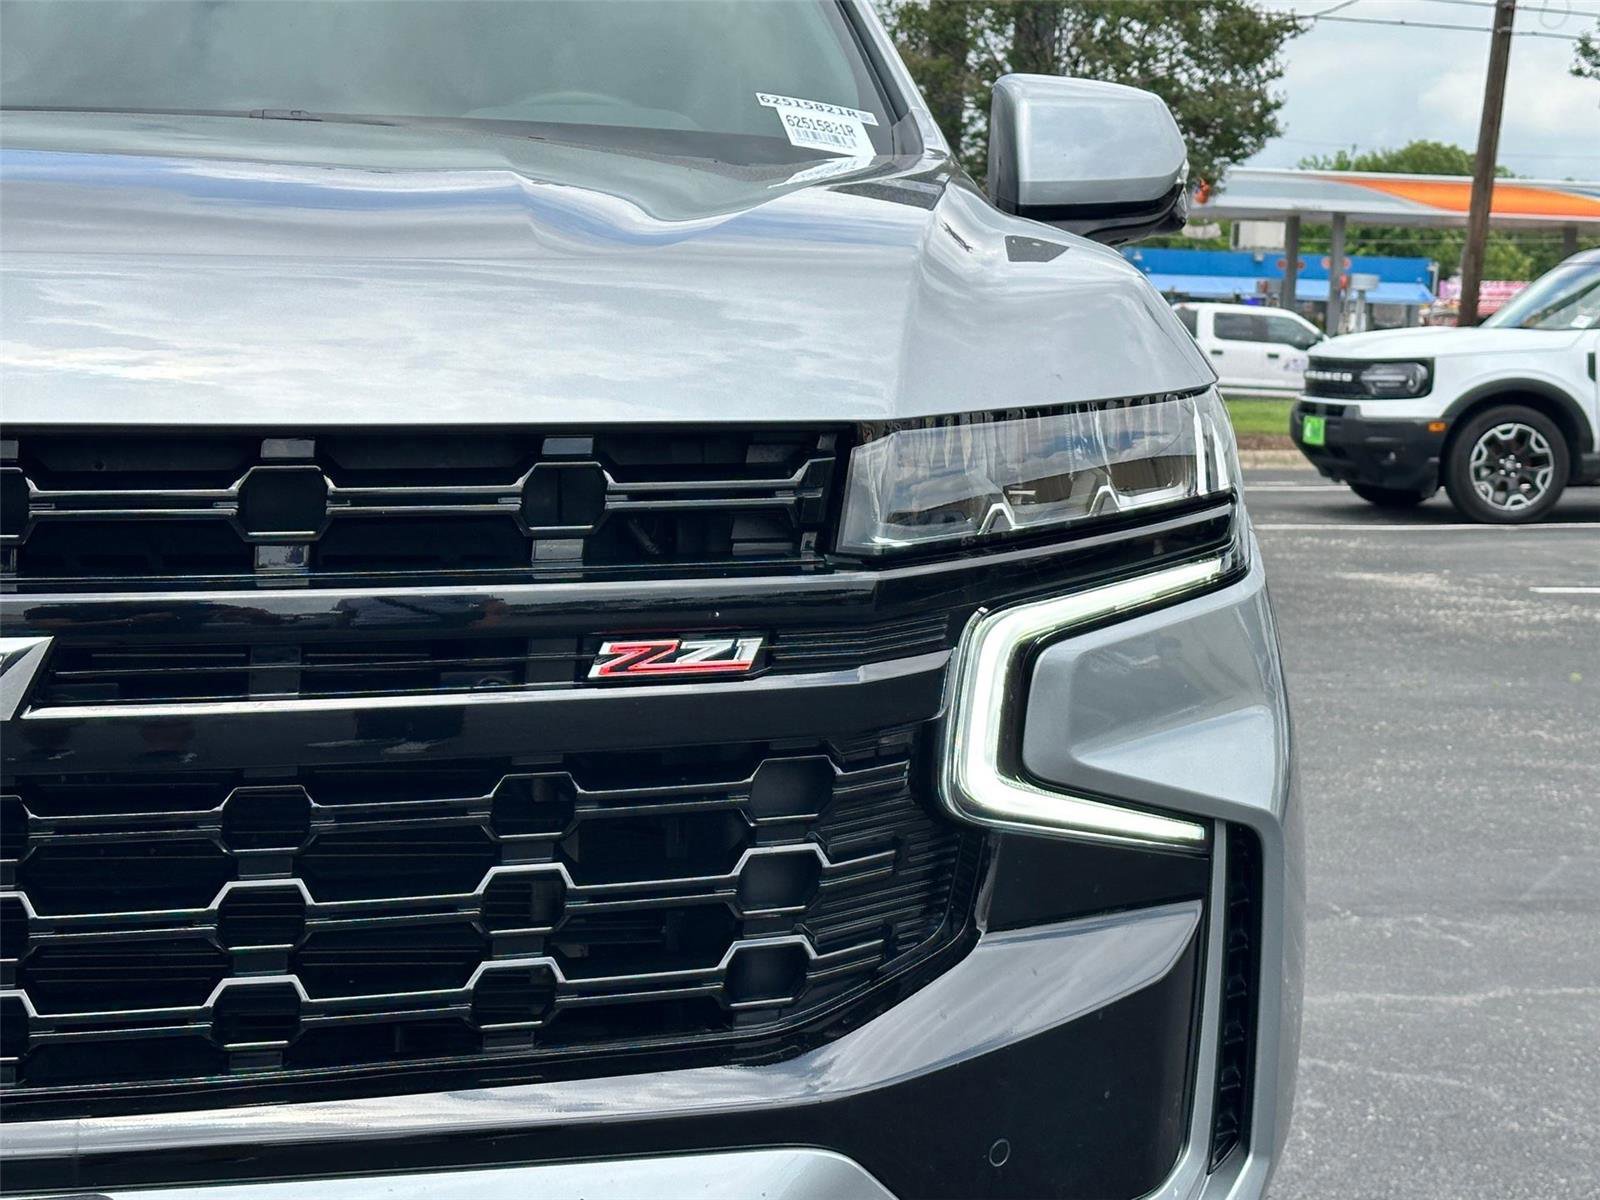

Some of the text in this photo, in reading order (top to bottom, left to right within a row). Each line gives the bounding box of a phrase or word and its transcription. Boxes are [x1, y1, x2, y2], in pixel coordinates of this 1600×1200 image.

[760, 94, 858, 118] 62515821R
[785, 114, 857, 138] 62515821R
[588, 637, 764, 678] Z71
